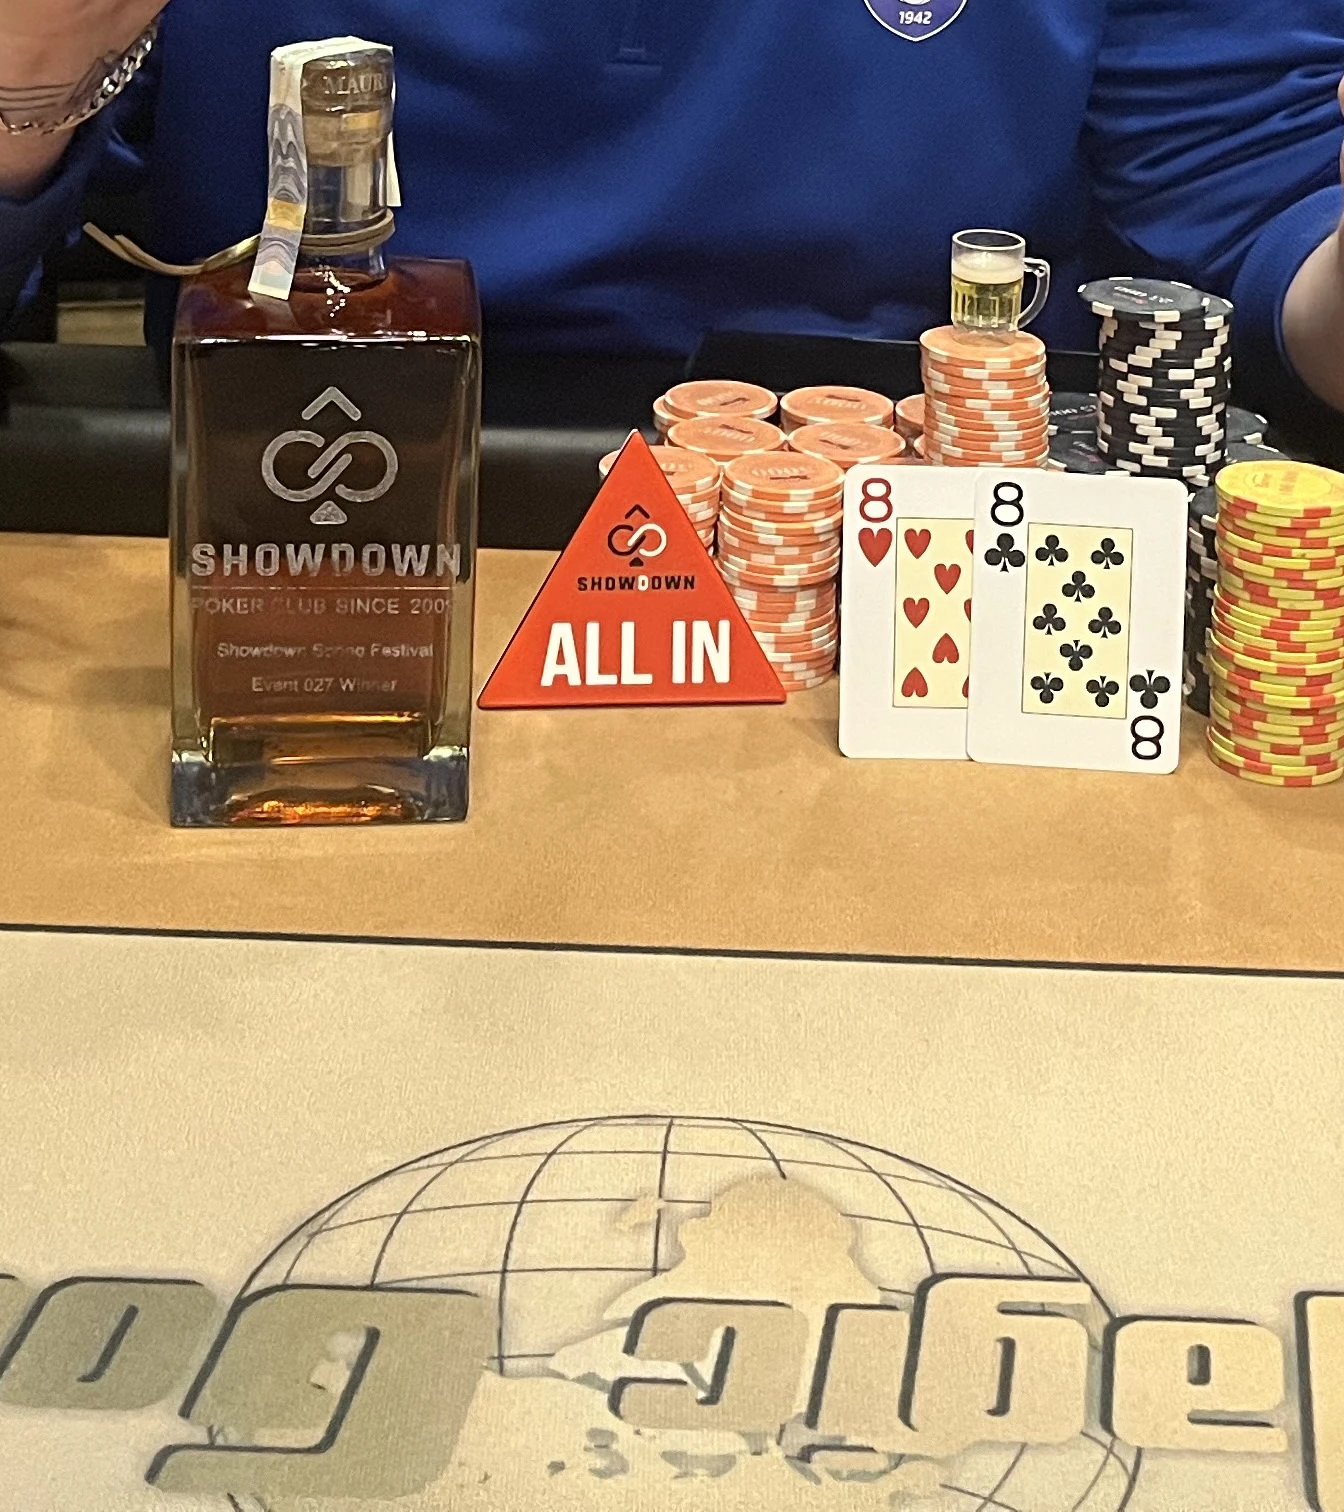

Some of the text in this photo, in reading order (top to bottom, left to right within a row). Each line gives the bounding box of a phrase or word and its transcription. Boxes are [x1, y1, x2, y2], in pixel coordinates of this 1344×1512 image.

[898, 10, 933, 25] 1942
[859, 477, 893, 523] 8
[990, 481, 1024, 527] 8
[191, 543, 462, 577] SHOWDOWN
[577, 575, 696, 592] SHOWDOWN
[191, 598, 264, 614] POKER
[335, 598, 400, 614] SINCE
[370, 642, 434, 658] Festival
[540, 619, 731, 687] ALL IN
[251, 676, 299, 692] Event
[303, 677, 335, 692] 027
[1130, 715, 1164, 761] 8
